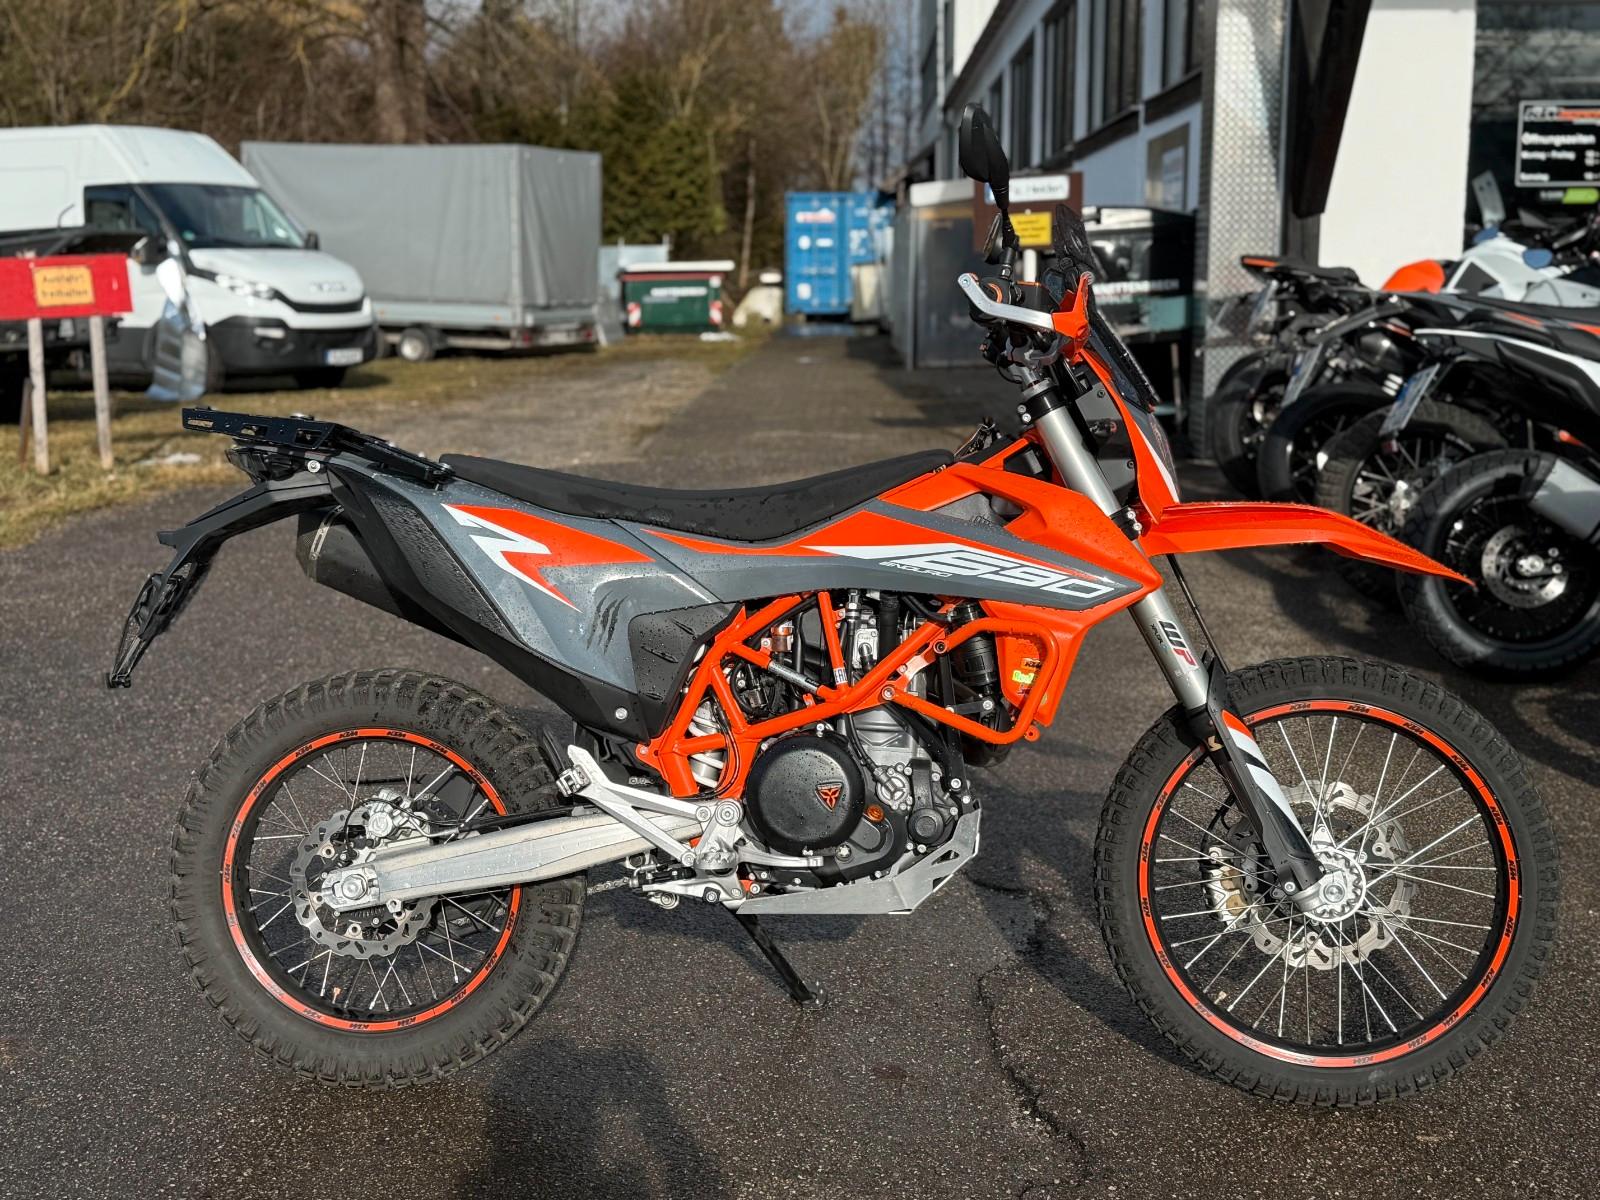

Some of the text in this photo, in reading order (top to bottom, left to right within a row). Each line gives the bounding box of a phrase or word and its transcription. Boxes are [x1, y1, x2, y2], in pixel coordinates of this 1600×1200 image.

[879, 561, 952, 578] ENDURO
[896, 550, 1115, 599] 690
[1158, 620, 1196, 666] WP
[1289, 701, 1310, 710] KTM
[1346, 703, 1370, 712] KTM
[339, 729, 358, 739] KTM
[386, 729, 407, 738] KTM
[1402, 721, 1425, 734] KTM
[296, 742, 311, 758] KTM
[428, 742, 449, 753] KTM
[1449, 754, 1470, 769] KTM
[467, 769, 485, 782] KTM
[253, 777, 265, 797] KTM
[1155, 790, 1167, 811] KTM
[1489, 805, 1504, 824] KTM
[1140, 840, 1149, 863] KTM
[223, 862, 231, 884] KTM
[1508, 859, 1516, 881] KTM
[1140, 896, 1150, 916] KTM
[506, 910, 516, 931] KTM
[1504, 915, 1514, 939] KTM
[485, 951, 498, 972] KTM
[1156, 951, 1171, 967] KTM
[1482, 967, 1494, 989] KTM
[451, 988, 466, 1006] KTM
[348, 1022, 369, 1030] KTM
[397, 1016, 416, 1027] KTM
[1445, 1011, 1458, 1029] KTM
